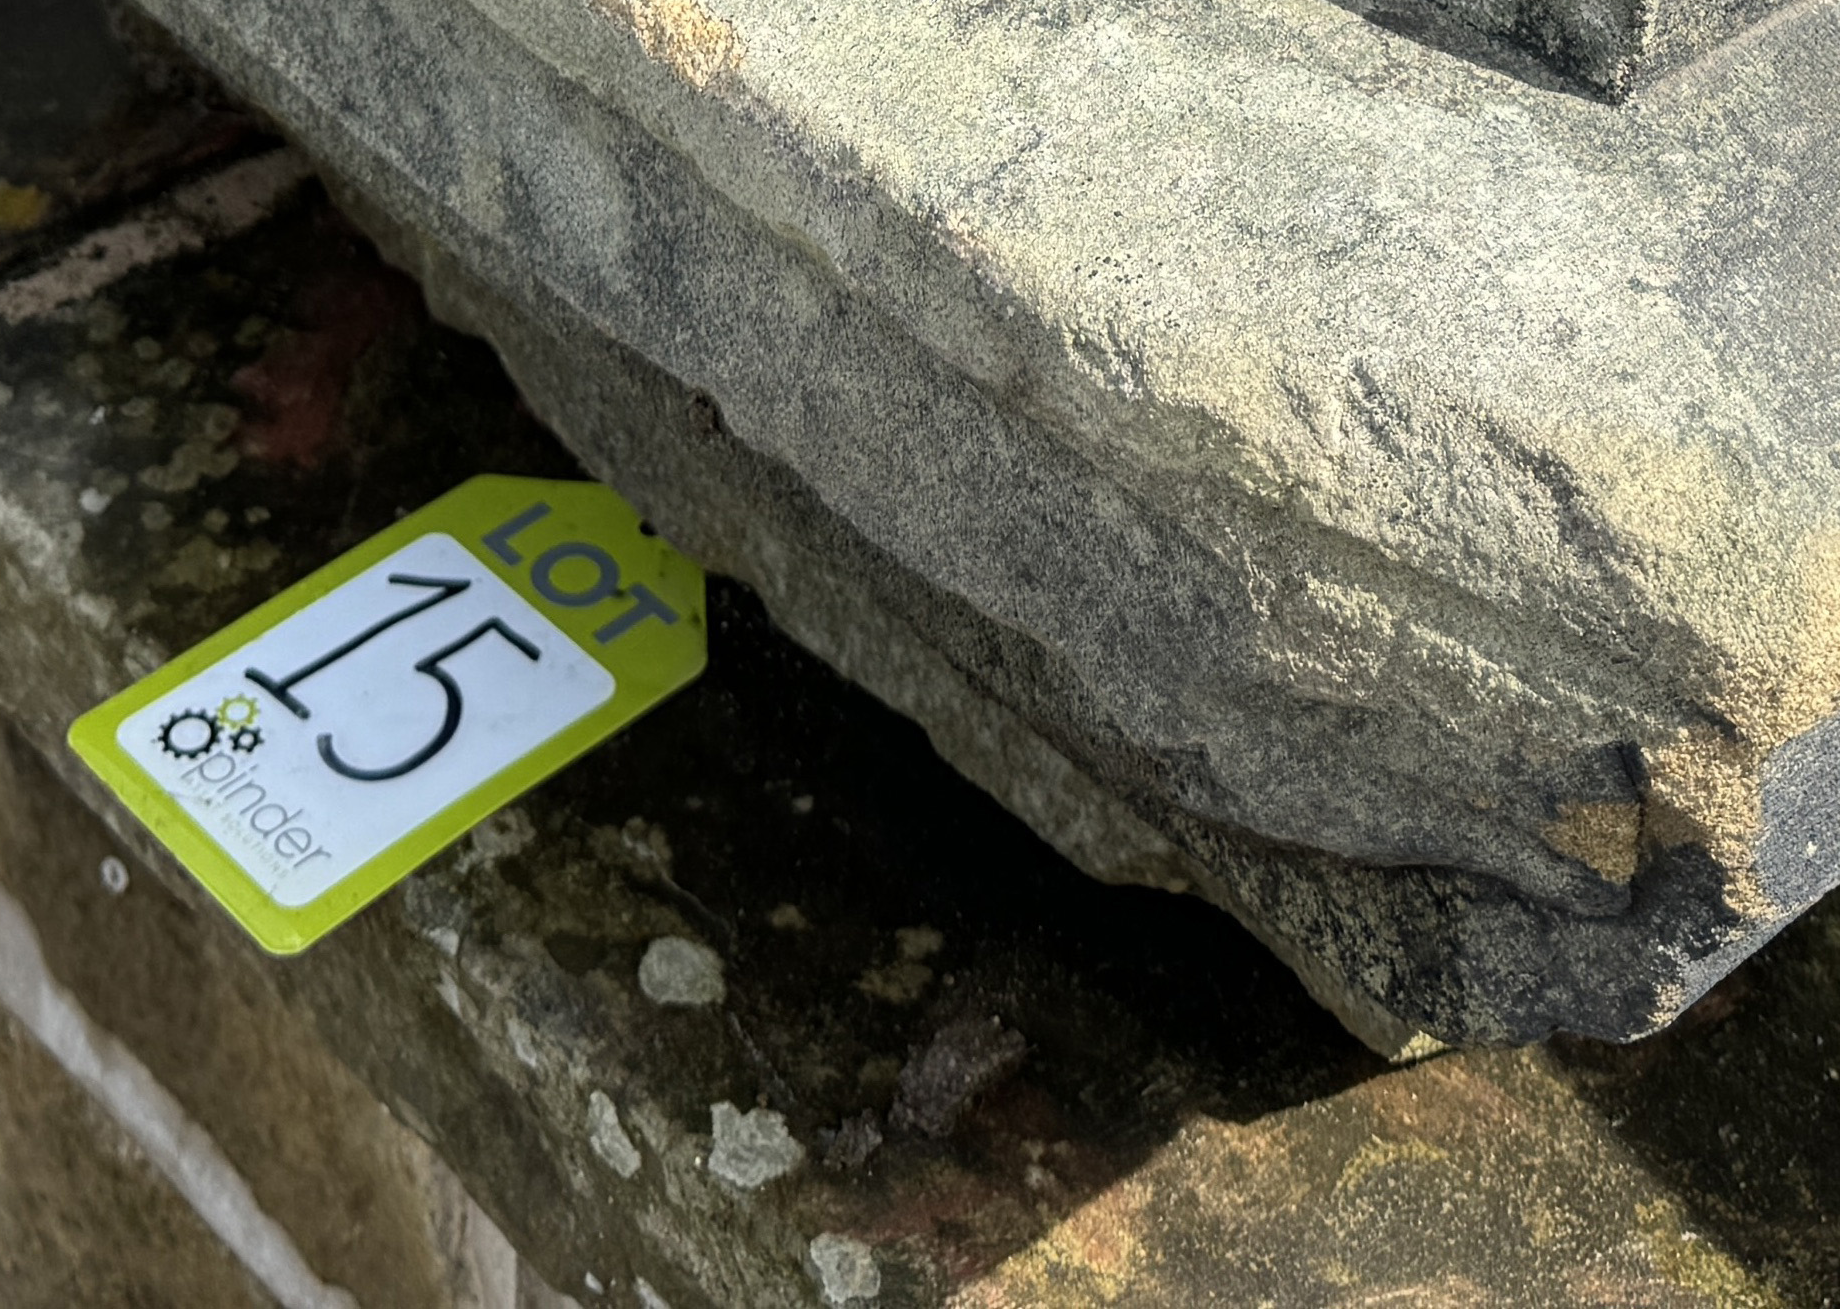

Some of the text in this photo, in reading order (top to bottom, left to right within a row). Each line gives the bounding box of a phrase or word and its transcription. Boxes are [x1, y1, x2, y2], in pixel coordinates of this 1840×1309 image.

[481, 500, 680, 645] LOT
[243, 572, 541, 782] 15
[180, 749, 332, 870] pinder
